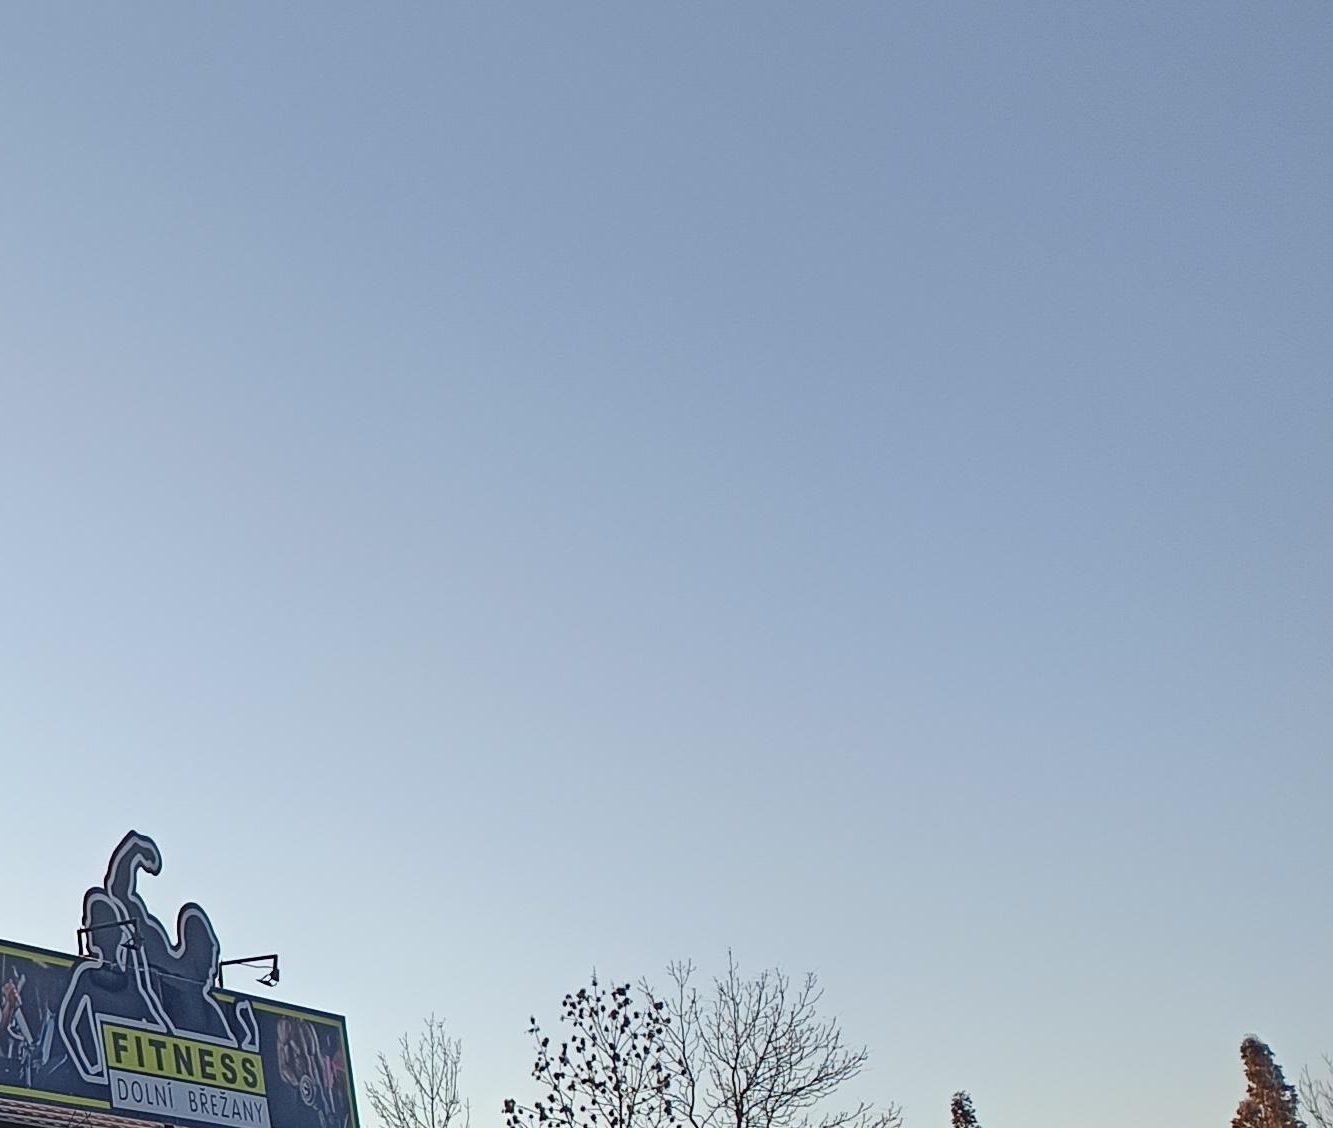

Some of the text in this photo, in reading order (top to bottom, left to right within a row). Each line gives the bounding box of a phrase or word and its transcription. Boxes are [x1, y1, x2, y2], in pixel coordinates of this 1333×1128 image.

[111, 1031, 259, 1089] FITNESS
[117, 1077, 263, 1123] DOLNÍ BŘEŽANY
